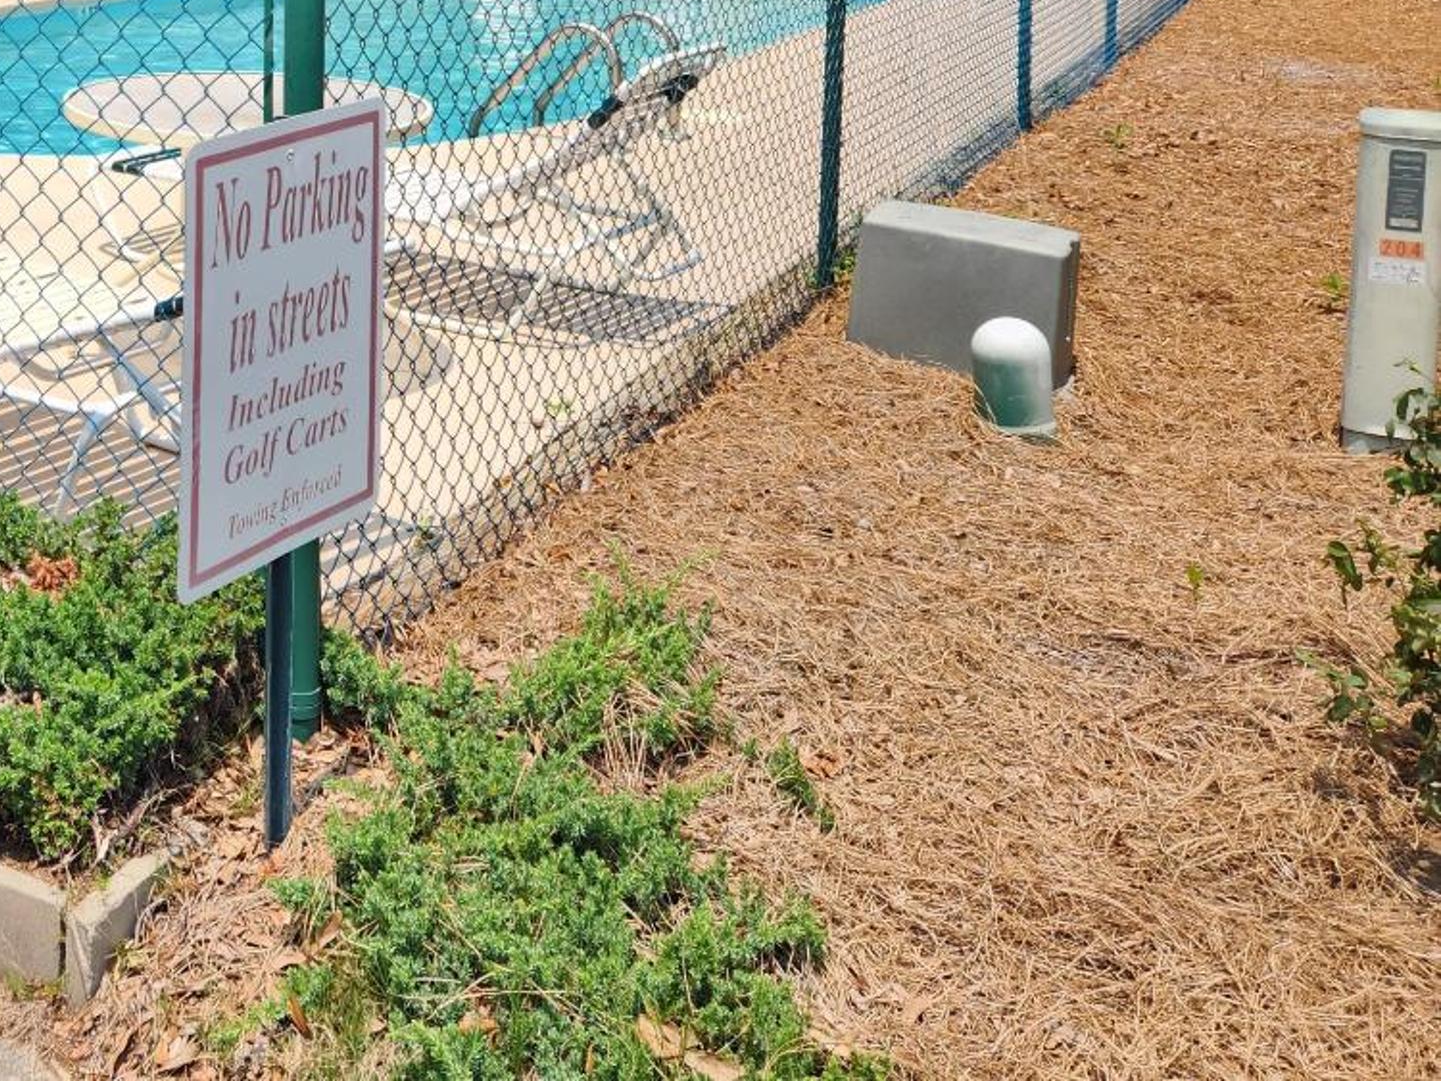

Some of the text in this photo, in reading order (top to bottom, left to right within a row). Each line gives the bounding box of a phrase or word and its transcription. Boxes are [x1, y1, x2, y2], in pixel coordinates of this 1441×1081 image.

[211, 149, 368, 269] No Parking
[1380, 239, 1422, 259] 204
[229, 262, 351, 375] in streets
[228, 360, 347, 432] Including
[224, 407, 349, 484] Golf Carts
[227, 463, 343, 539] Towing Enforced
